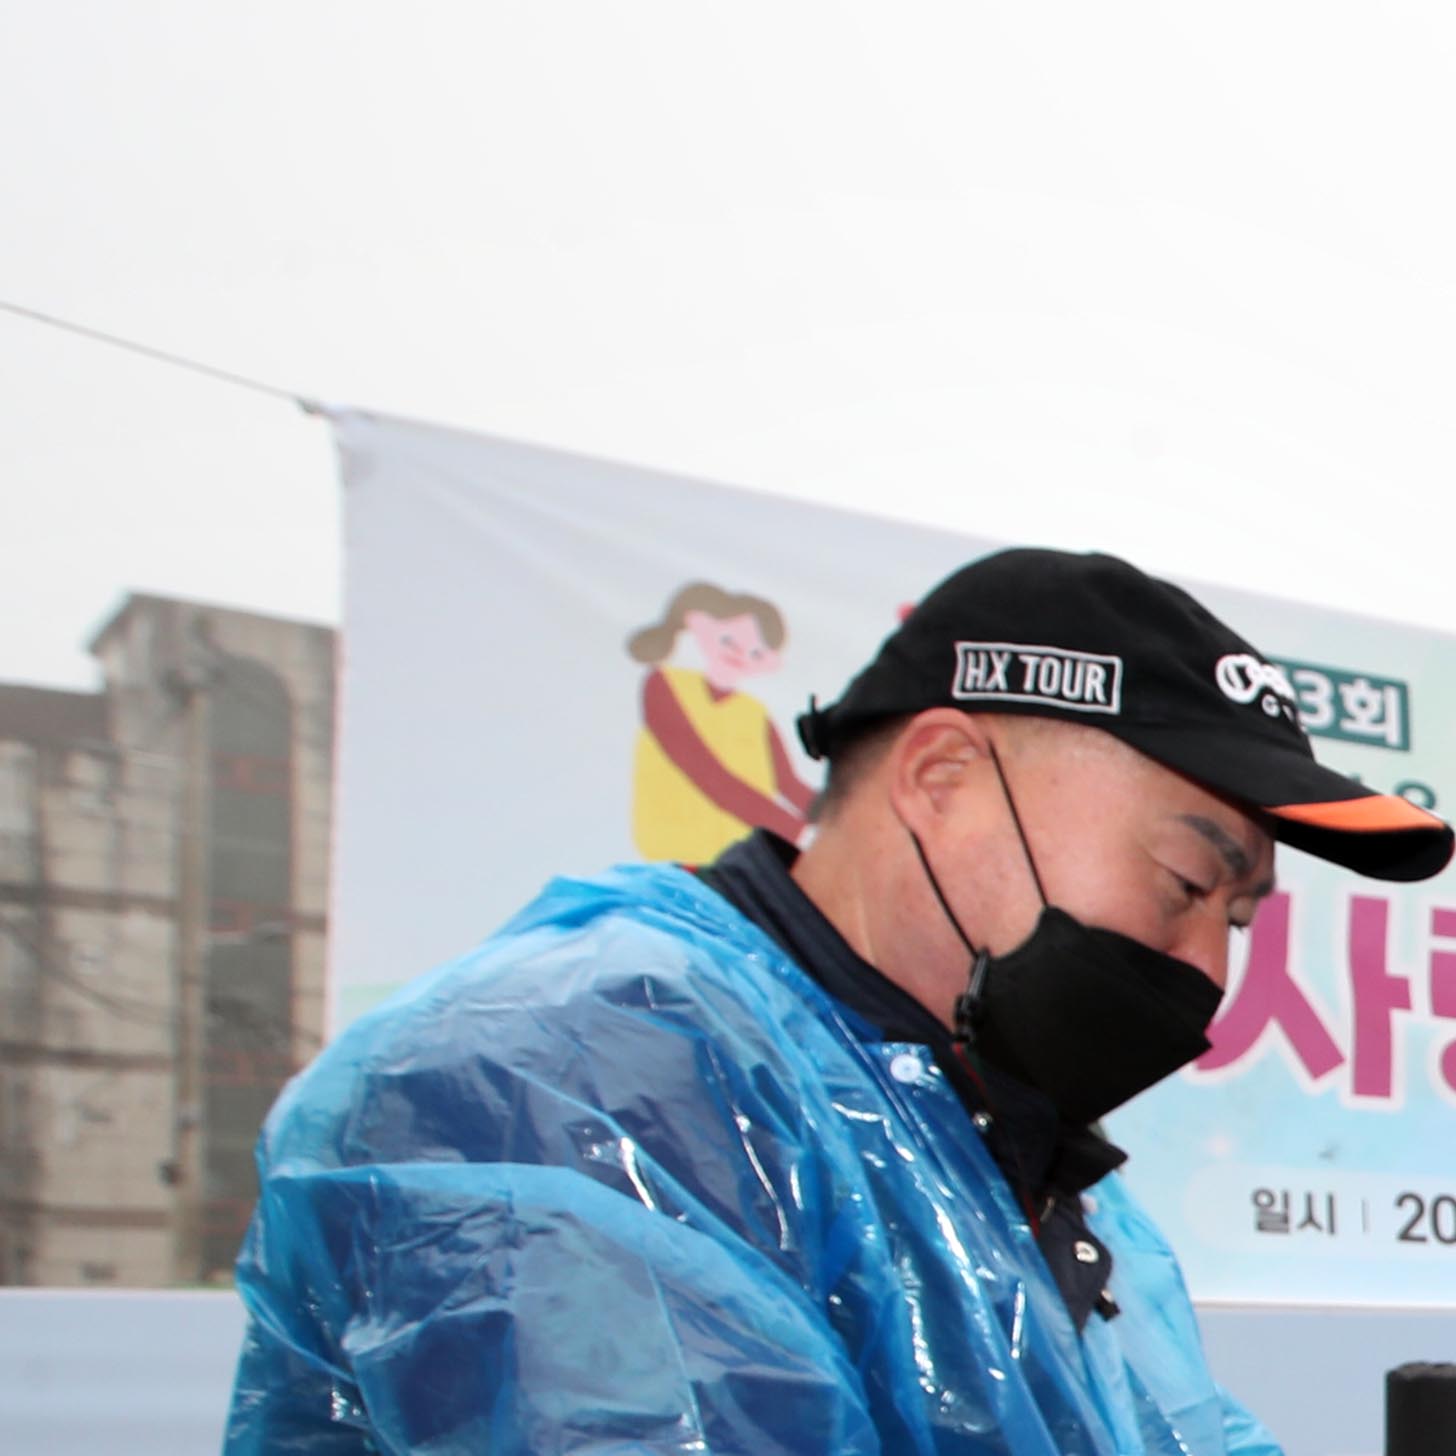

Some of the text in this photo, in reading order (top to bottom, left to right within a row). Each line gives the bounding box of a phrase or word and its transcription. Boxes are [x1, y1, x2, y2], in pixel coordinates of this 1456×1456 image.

[962, 648, 1108, 703] HX TOUR
[1290, 668, 1402, 746] 3회
[1251, 1187, 1337, 1235] 일시
